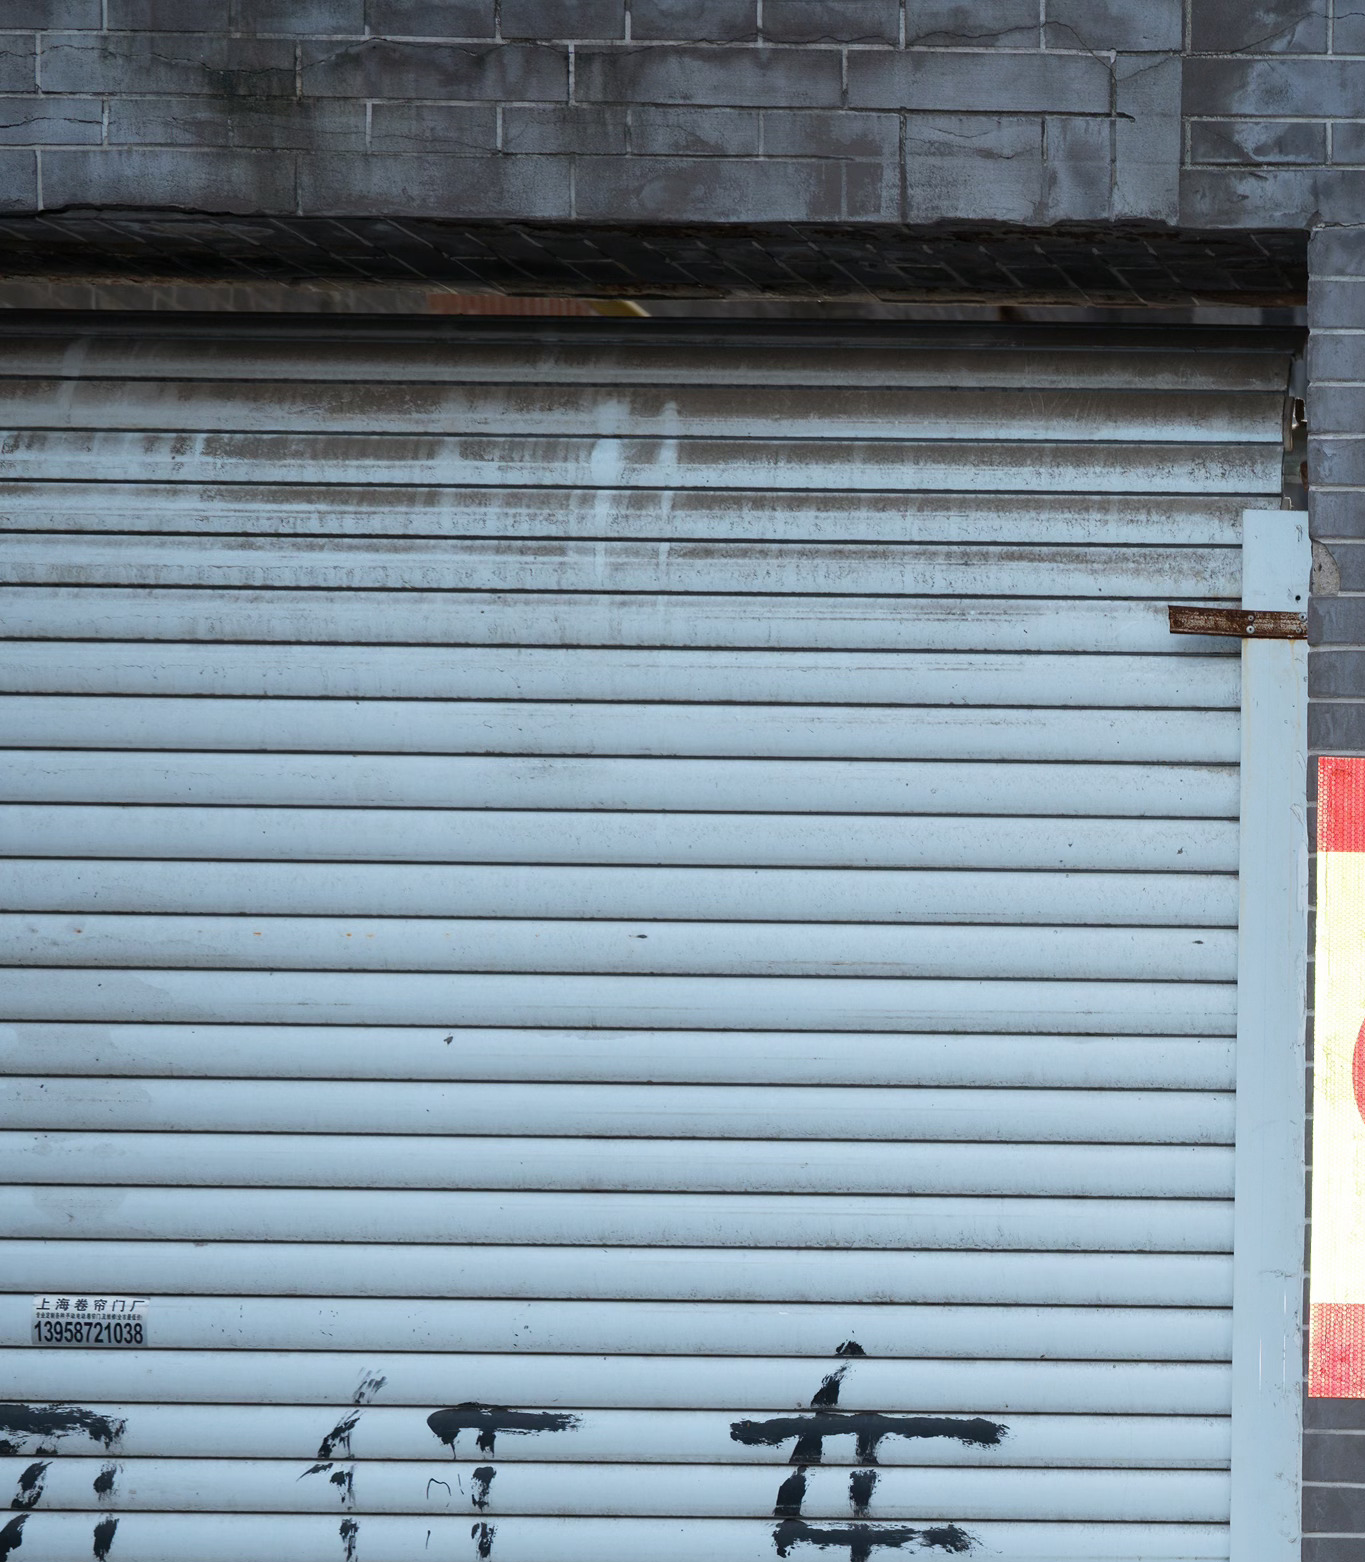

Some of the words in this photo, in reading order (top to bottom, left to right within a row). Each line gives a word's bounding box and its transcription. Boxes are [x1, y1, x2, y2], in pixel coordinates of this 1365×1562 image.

[36, 1298, 145, 1312] 上海卷帘门厂
[34, 1320, 143, 1344] 13958721038
